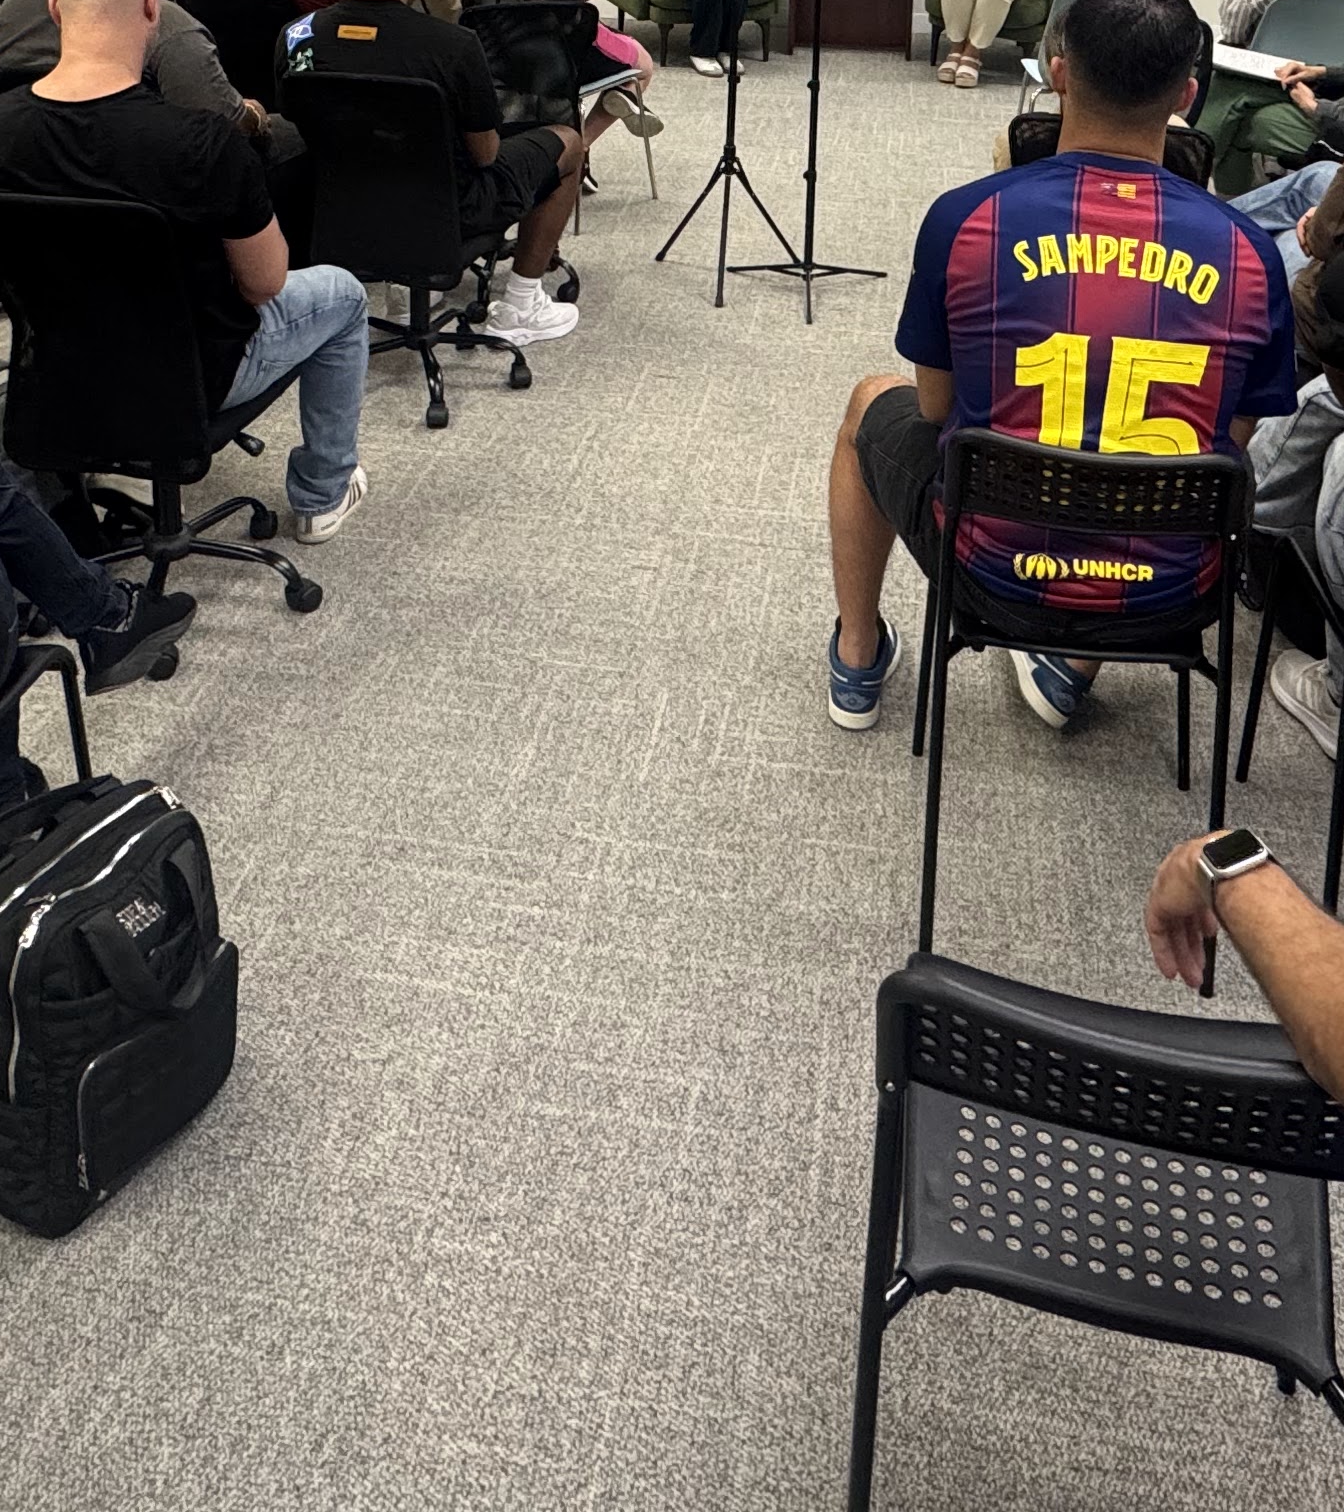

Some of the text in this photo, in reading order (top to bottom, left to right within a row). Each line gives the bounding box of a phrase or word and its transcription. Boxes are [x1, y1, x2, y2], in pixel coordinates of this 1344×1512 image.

[1013, 234, 1220, 305] SAMPEDRO
[1015, 332, 1212, 456] 15
[1072, 558, 1154, 582] UNHCR
